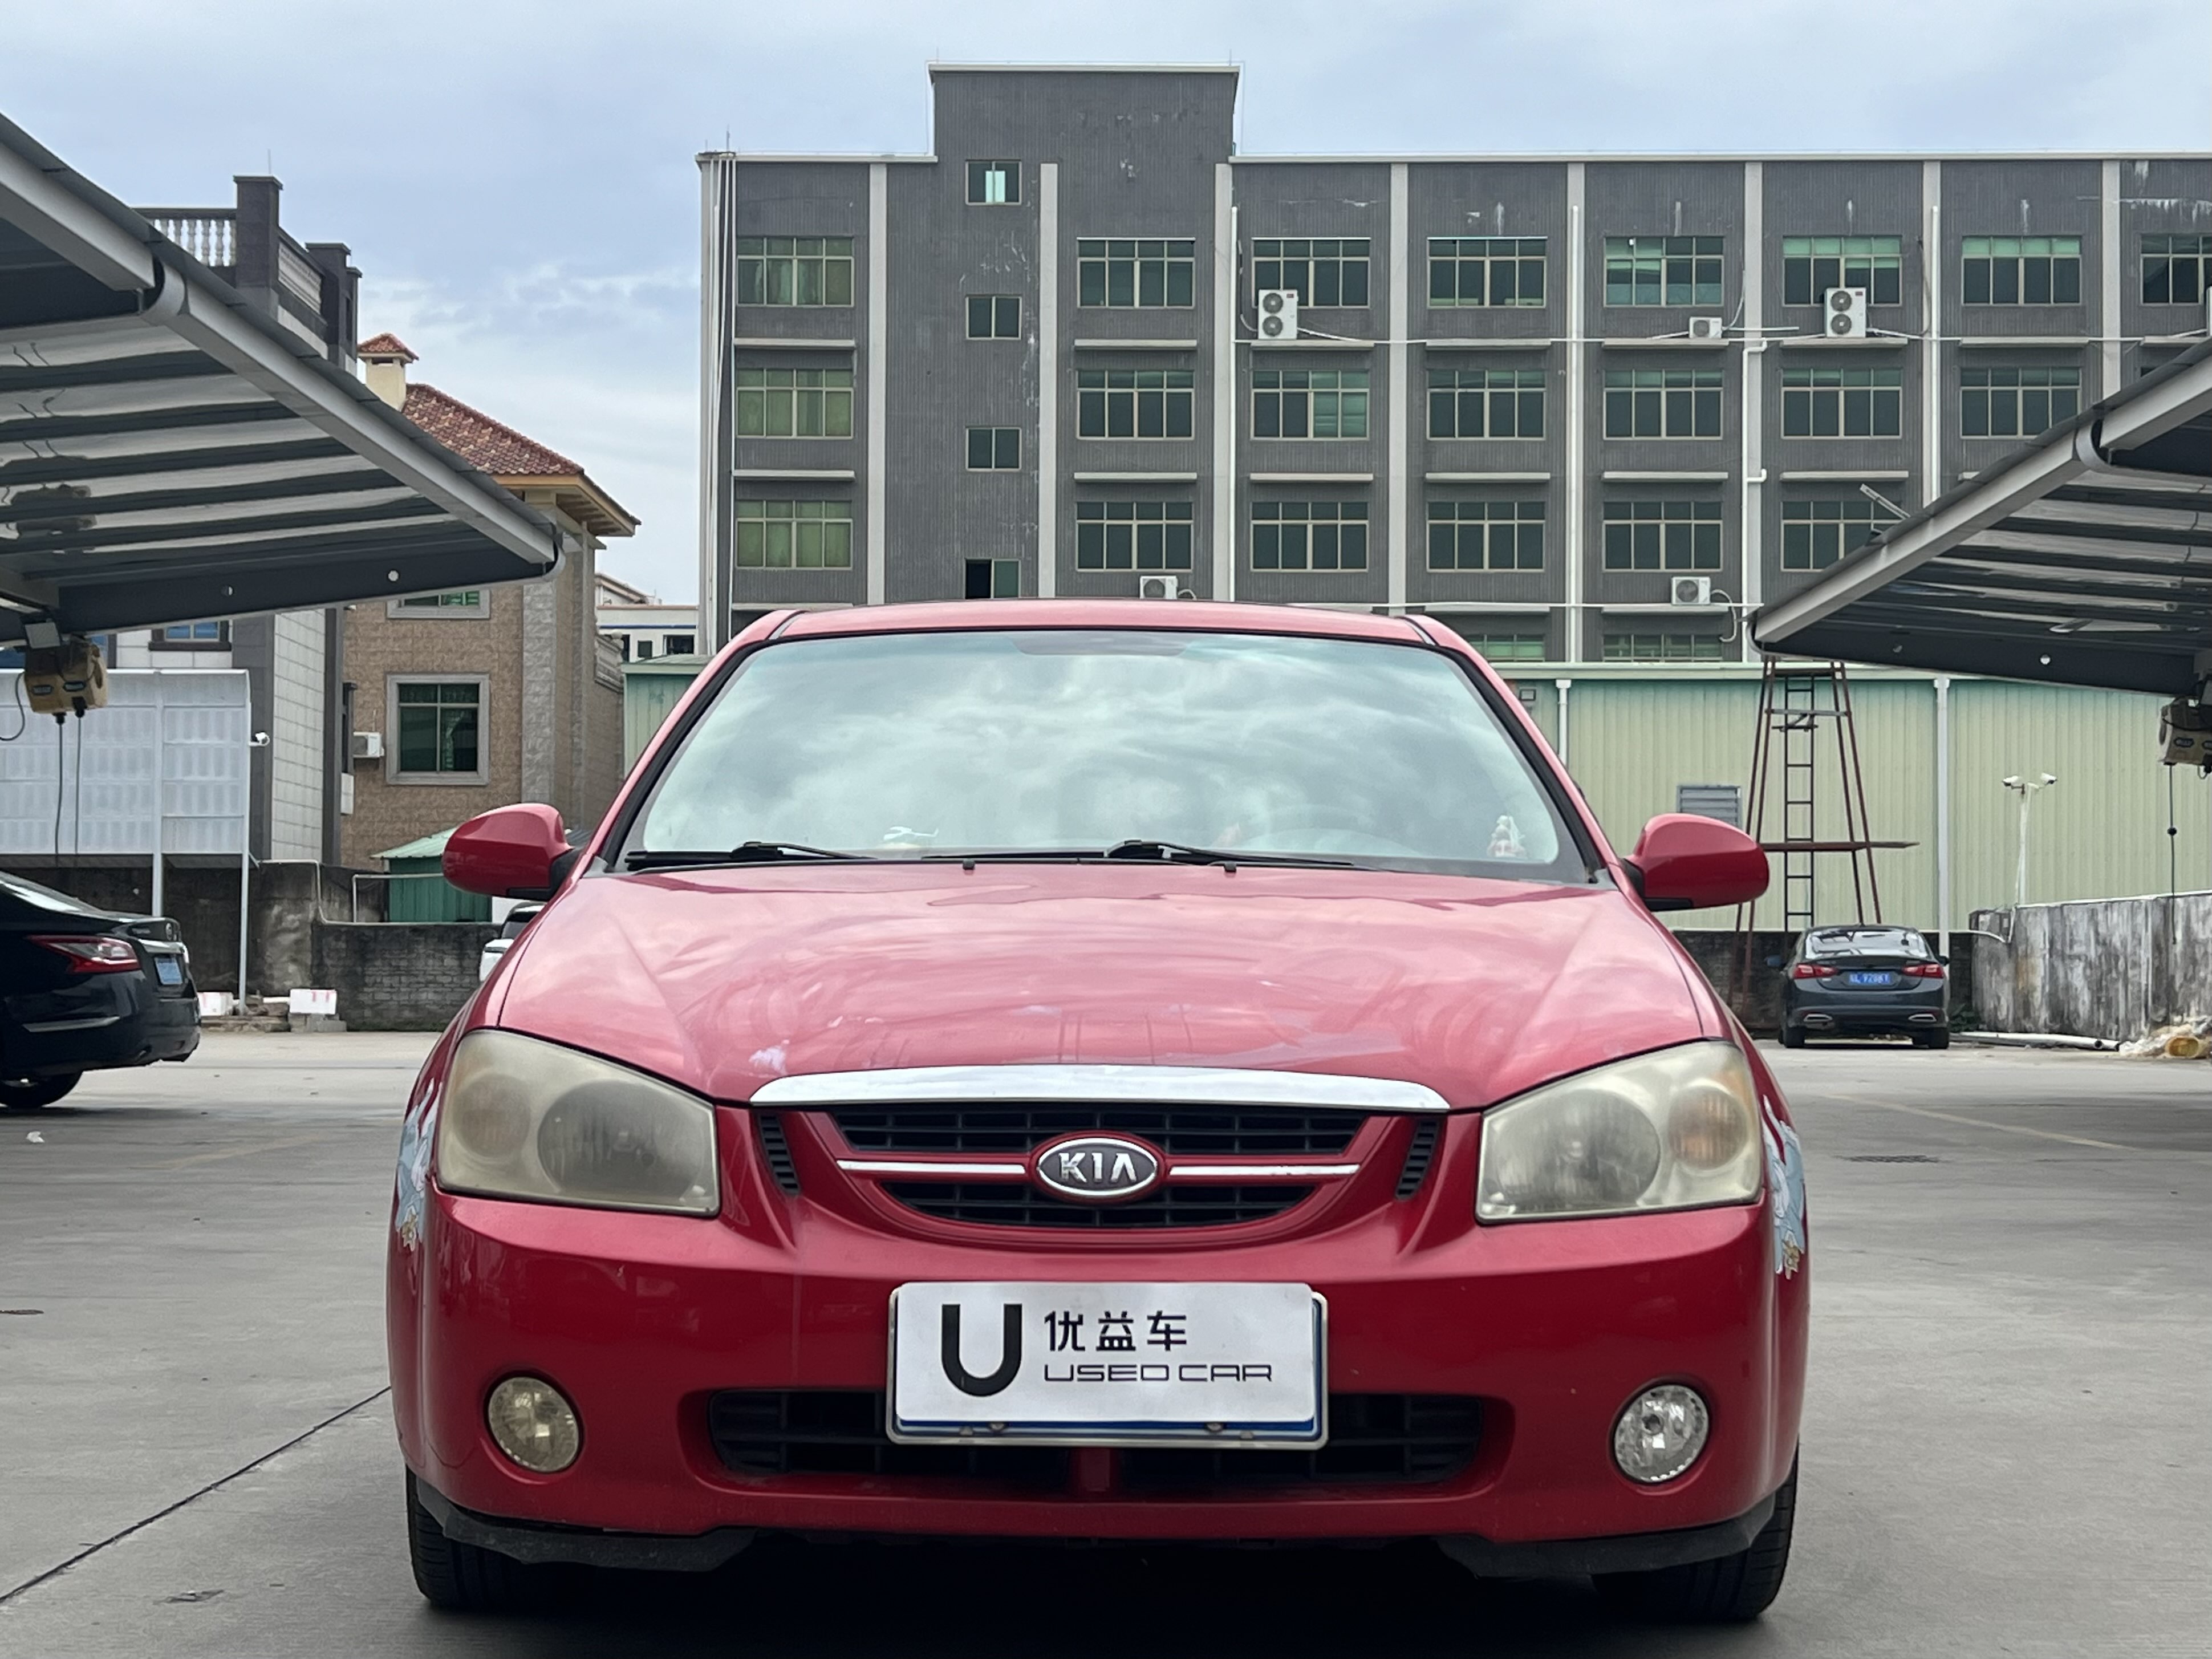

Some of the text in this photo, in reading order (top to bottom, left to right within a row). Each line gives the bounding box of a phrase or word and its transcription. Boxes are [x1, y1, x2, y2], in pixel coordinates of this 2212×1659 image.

[1058, 1152, 1137, 1183] KIA
[1044, 1311, 1187, 1352] 优益车
[941, 1304, 1022, 1397] U
[1044, 1364, 1272, 1382] USED CAR
